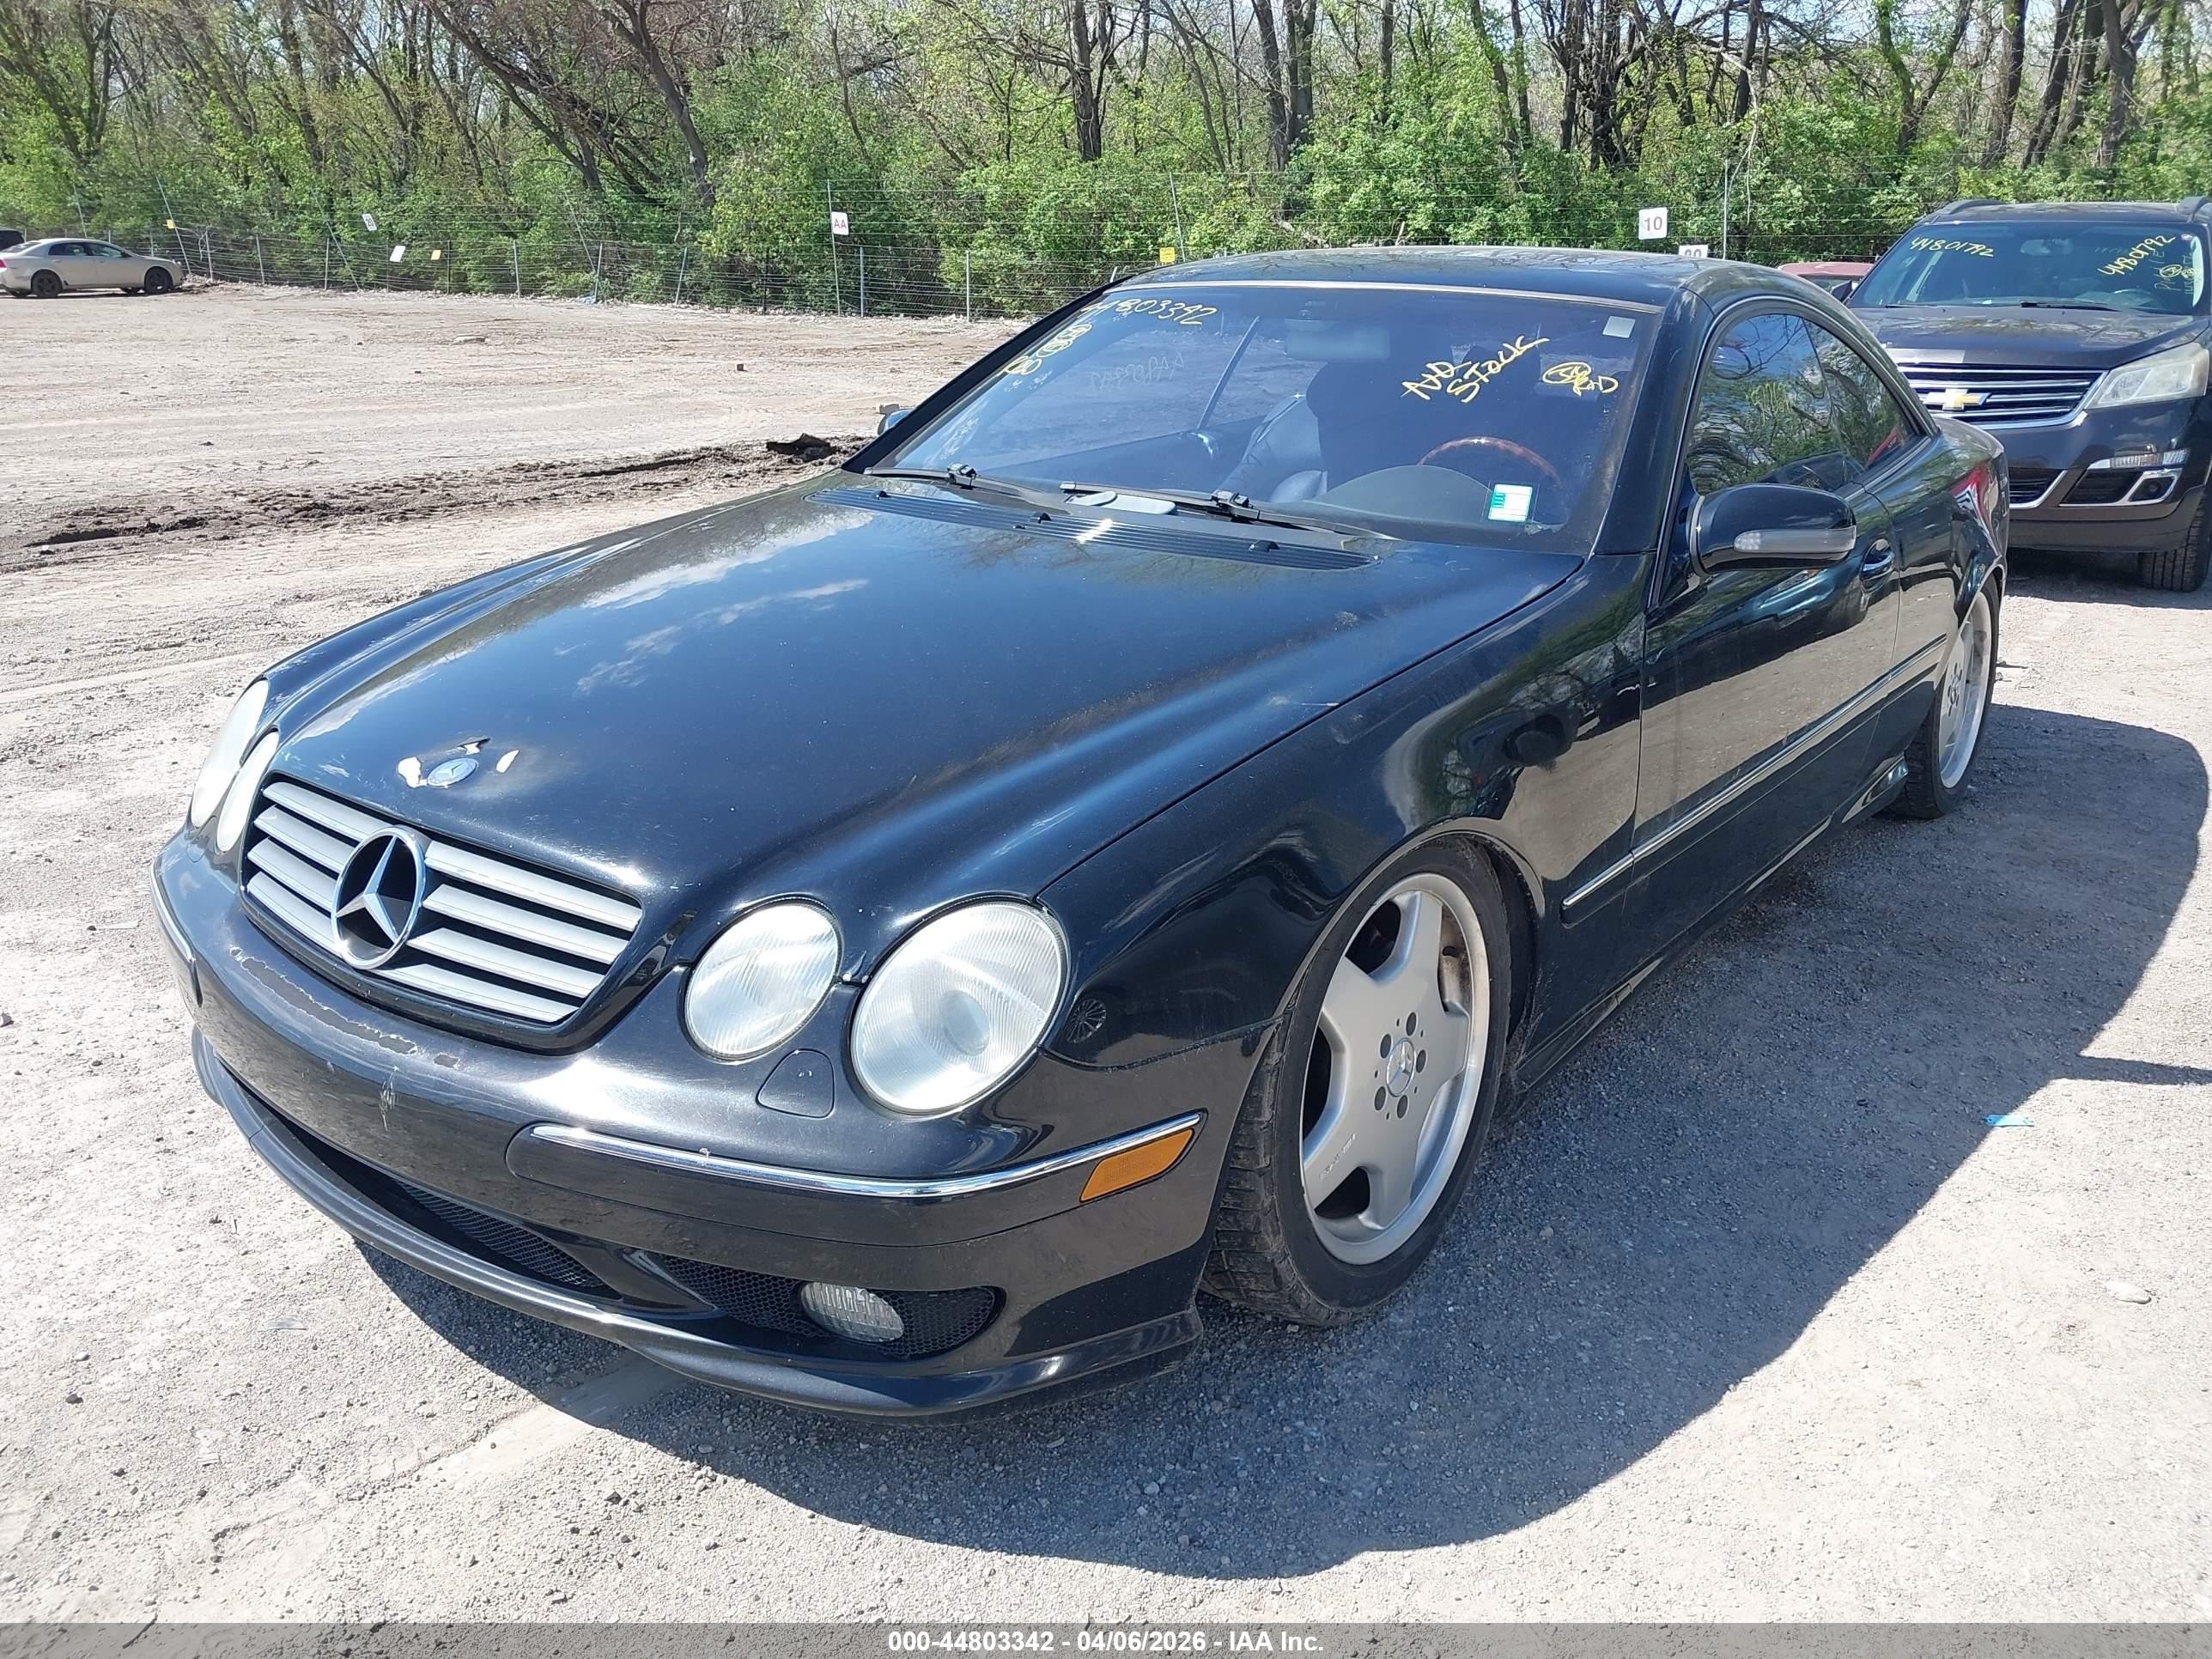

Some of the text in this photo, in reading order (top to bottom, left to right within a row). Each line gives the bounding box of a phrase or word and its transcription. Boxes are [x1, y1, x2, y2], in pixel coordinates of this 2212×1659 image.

[834, 217, 847, 229] AA
[1644, 216, 1663, 231] 10
[1909, 236, 1994, 258] 44801792
